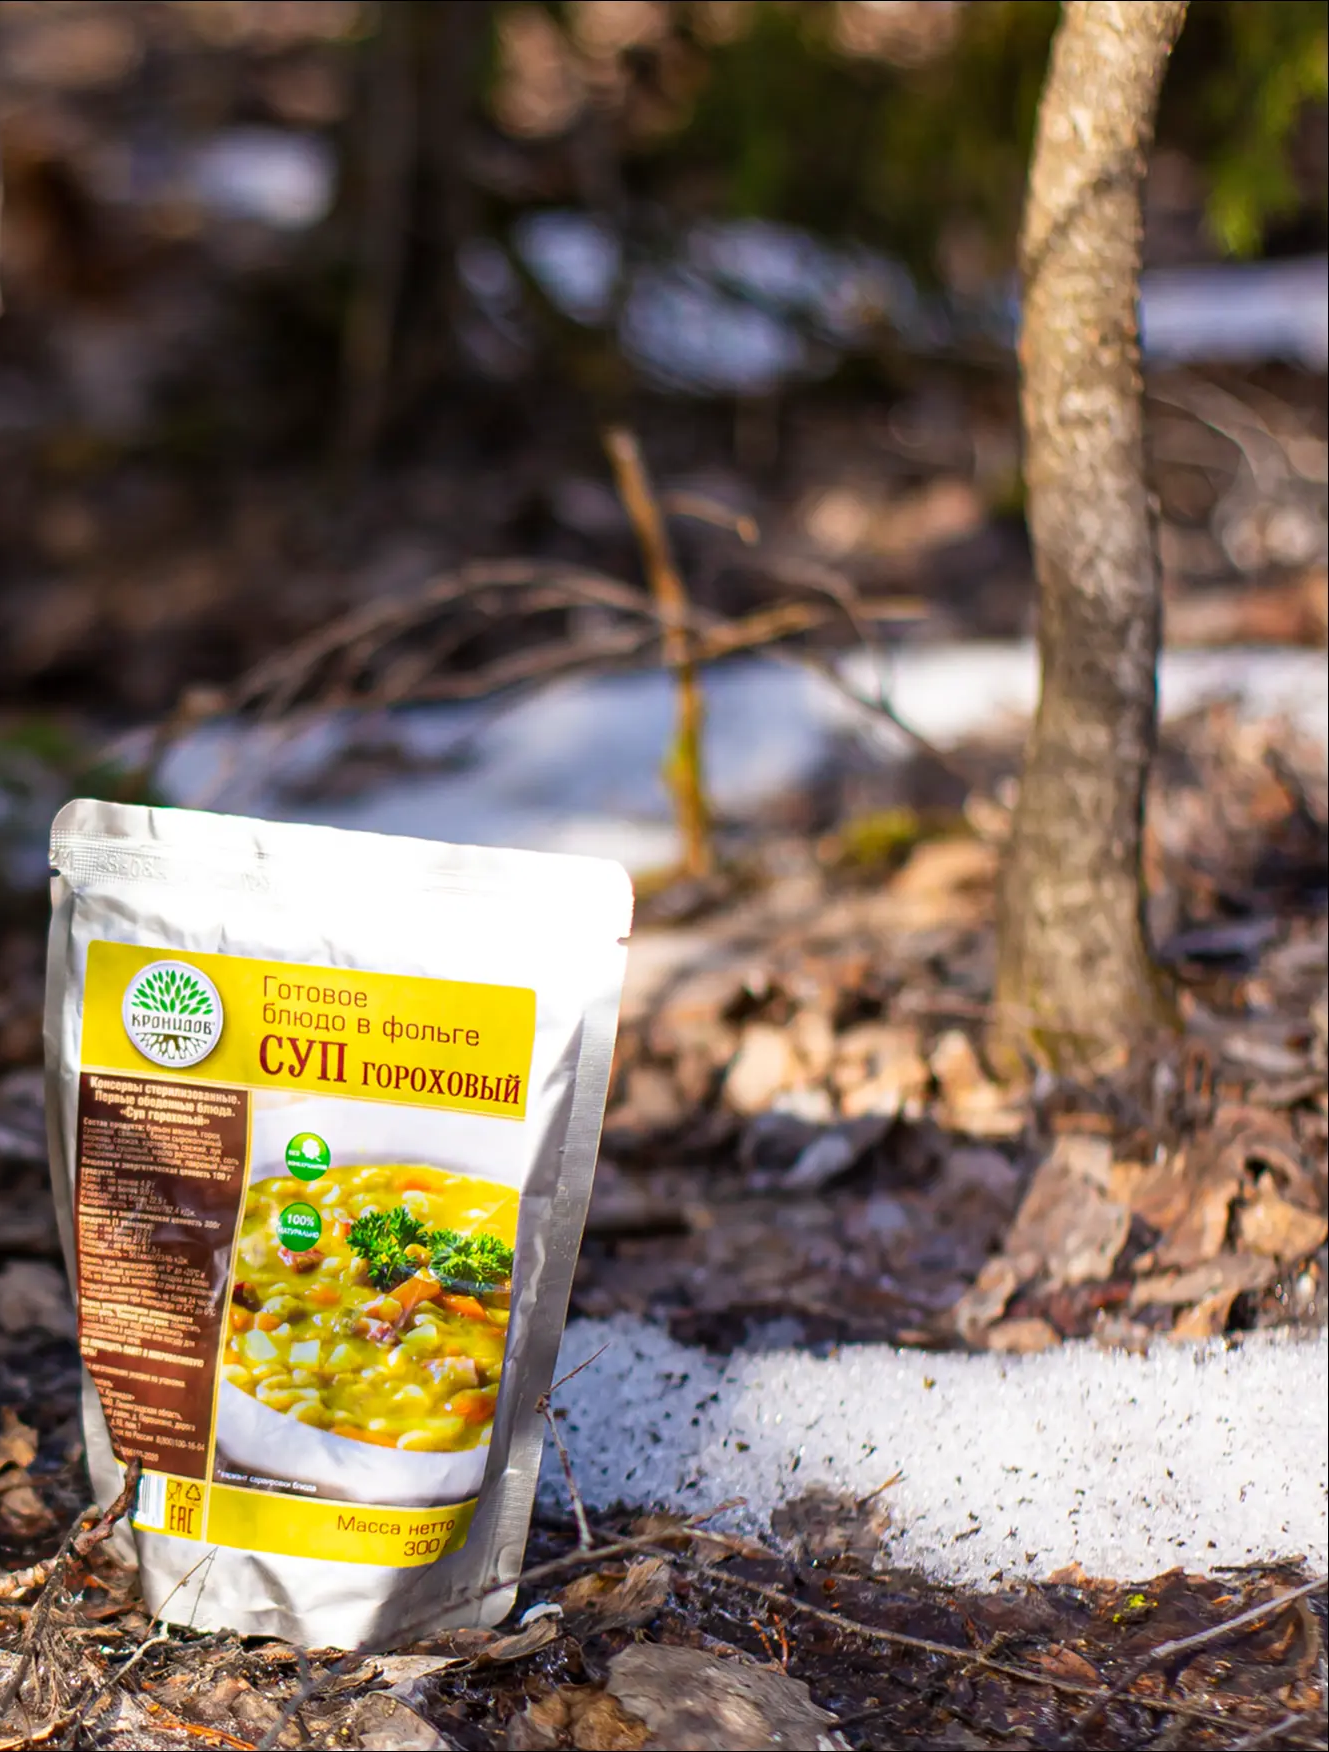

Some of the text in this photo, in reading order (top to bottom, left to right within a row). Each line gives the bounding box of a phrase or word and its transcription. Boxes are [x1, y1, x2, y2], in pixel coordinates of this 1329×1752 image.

[263, 975, 368, 1008] Готовое
[131, 1013, 212, 1035] КРОНИДОВ
[263, 1003, 480, 1046] блюдо в фольге
[259, 1034, 348, 1083] СУП
[90, 1076, 143, 1093] Консервы
[94, 1090, 136, 1106] Первые
[196, 1102, 236, 1117] блюда.
[287, 1213, 315, 1227] 100%
[337, 1514, 456, 1536] Масса нетто
[403, 1537, 440, 1557] 300
